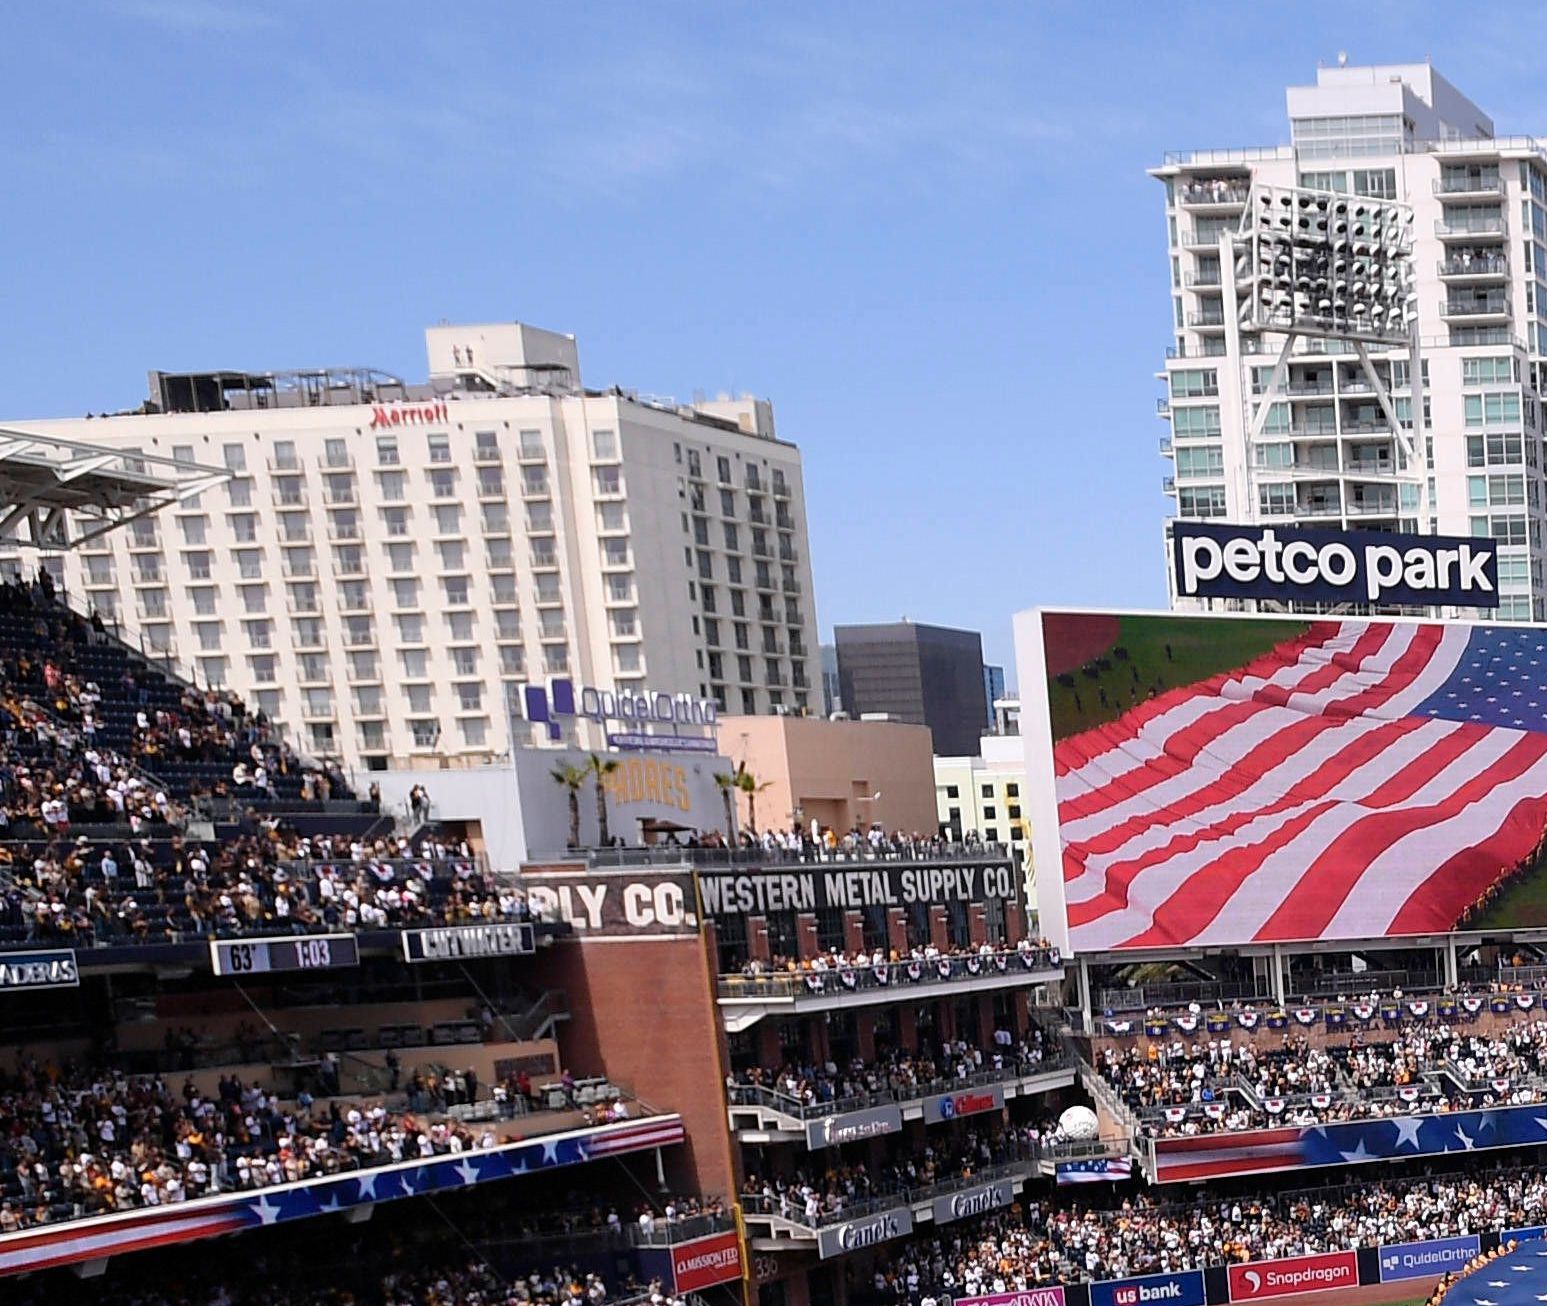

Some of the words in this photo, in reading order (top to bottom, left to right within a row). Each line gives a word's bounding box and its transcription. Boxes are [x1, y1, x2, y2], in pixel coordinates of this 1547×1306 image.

[1182, 529, 1356, 594] petco
[1365, 545, 1494, 600] park
[624, 882, 698, 927] CO.
[700, 873, 816, 914] WESTERN
[824, 870, 898, 908] METAL
[901, 867, 975, 904] SUPPLY
[983, 866, 1015, 899] CO.
[295, 940, 331, 968] 1:03
[839, 1213, 898, 1250] Canel's
[1116, 1289, 1137, 1304] us
[1139, 1281, 1181, 1302] bank
[1266, 1264, 1350, 1287] Snapdragon
